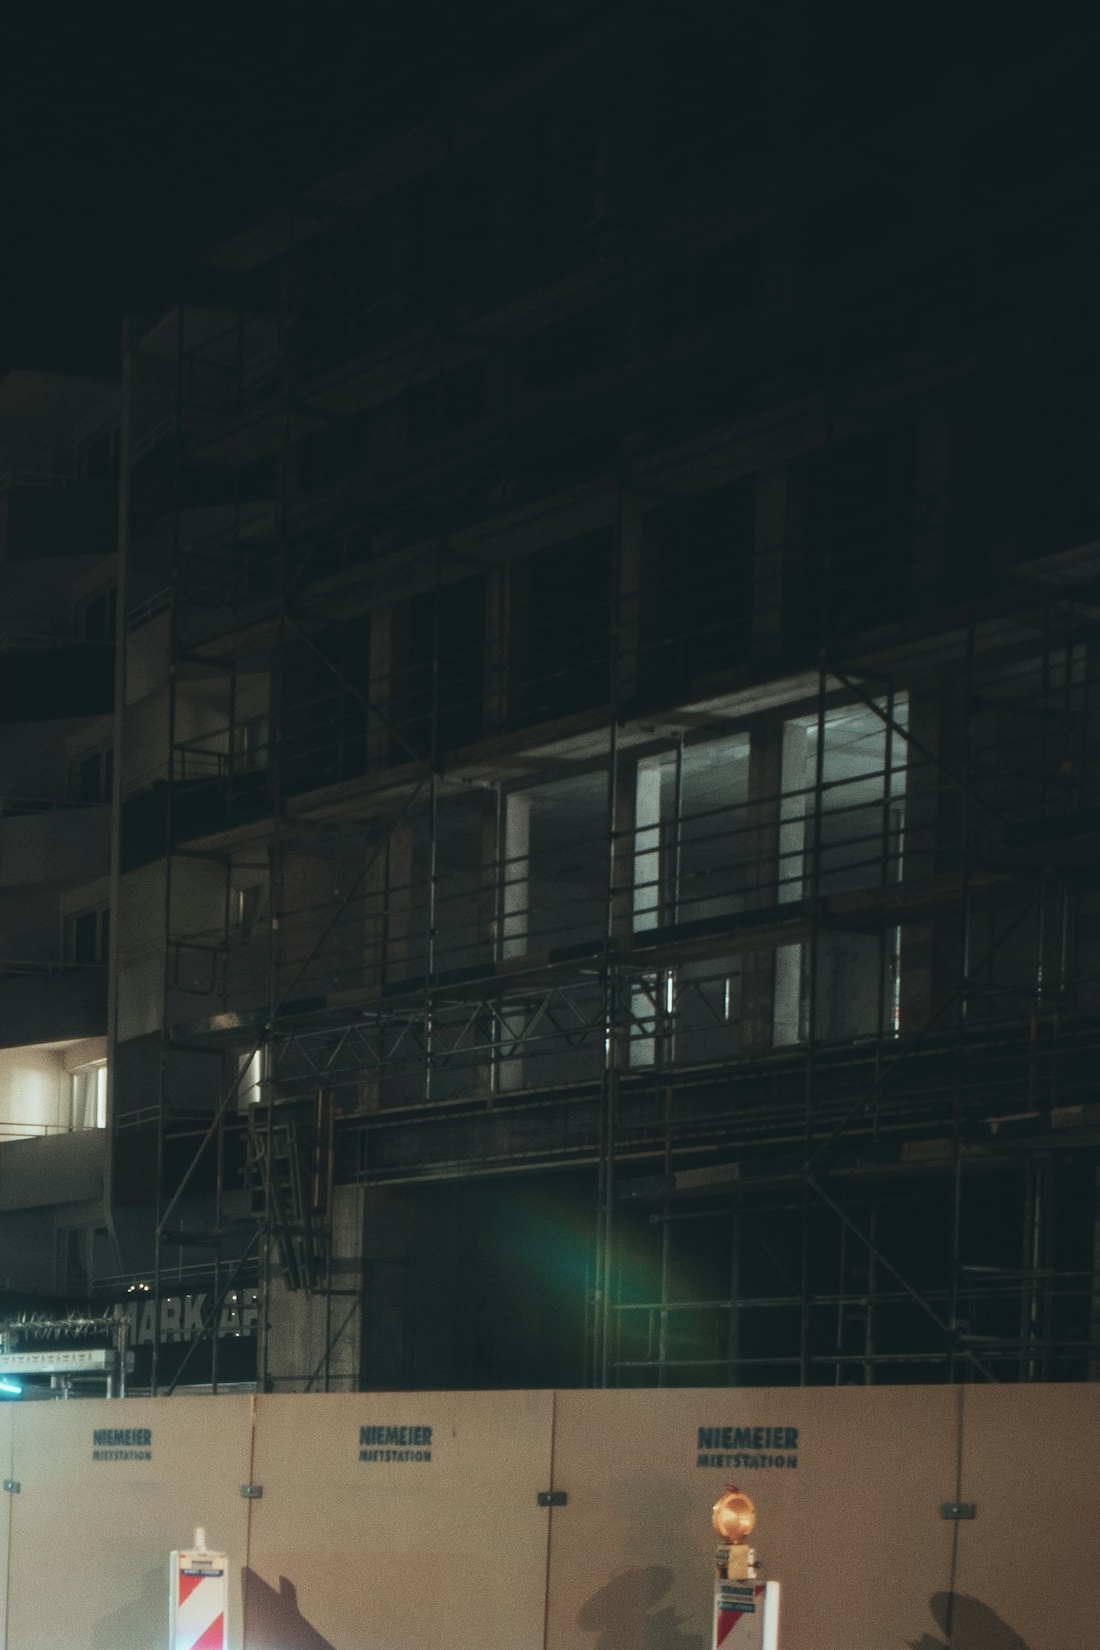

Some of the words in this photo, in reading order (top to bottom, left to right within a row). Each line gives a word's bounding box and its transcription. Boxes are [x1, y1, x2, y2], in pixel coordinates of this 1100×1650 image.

[113, 1292, 207, 1347] MARK
[93, 1428, 152, 1446] NIEMEIER
[360, 1426, 433, 1446] NIEMEIER
[697, 1427, 799, 1450] NIEMEIER
[359, 1450, 432, 1462] MIETSTATION
[696, 1453, 798, 1469] MIETSTATION
